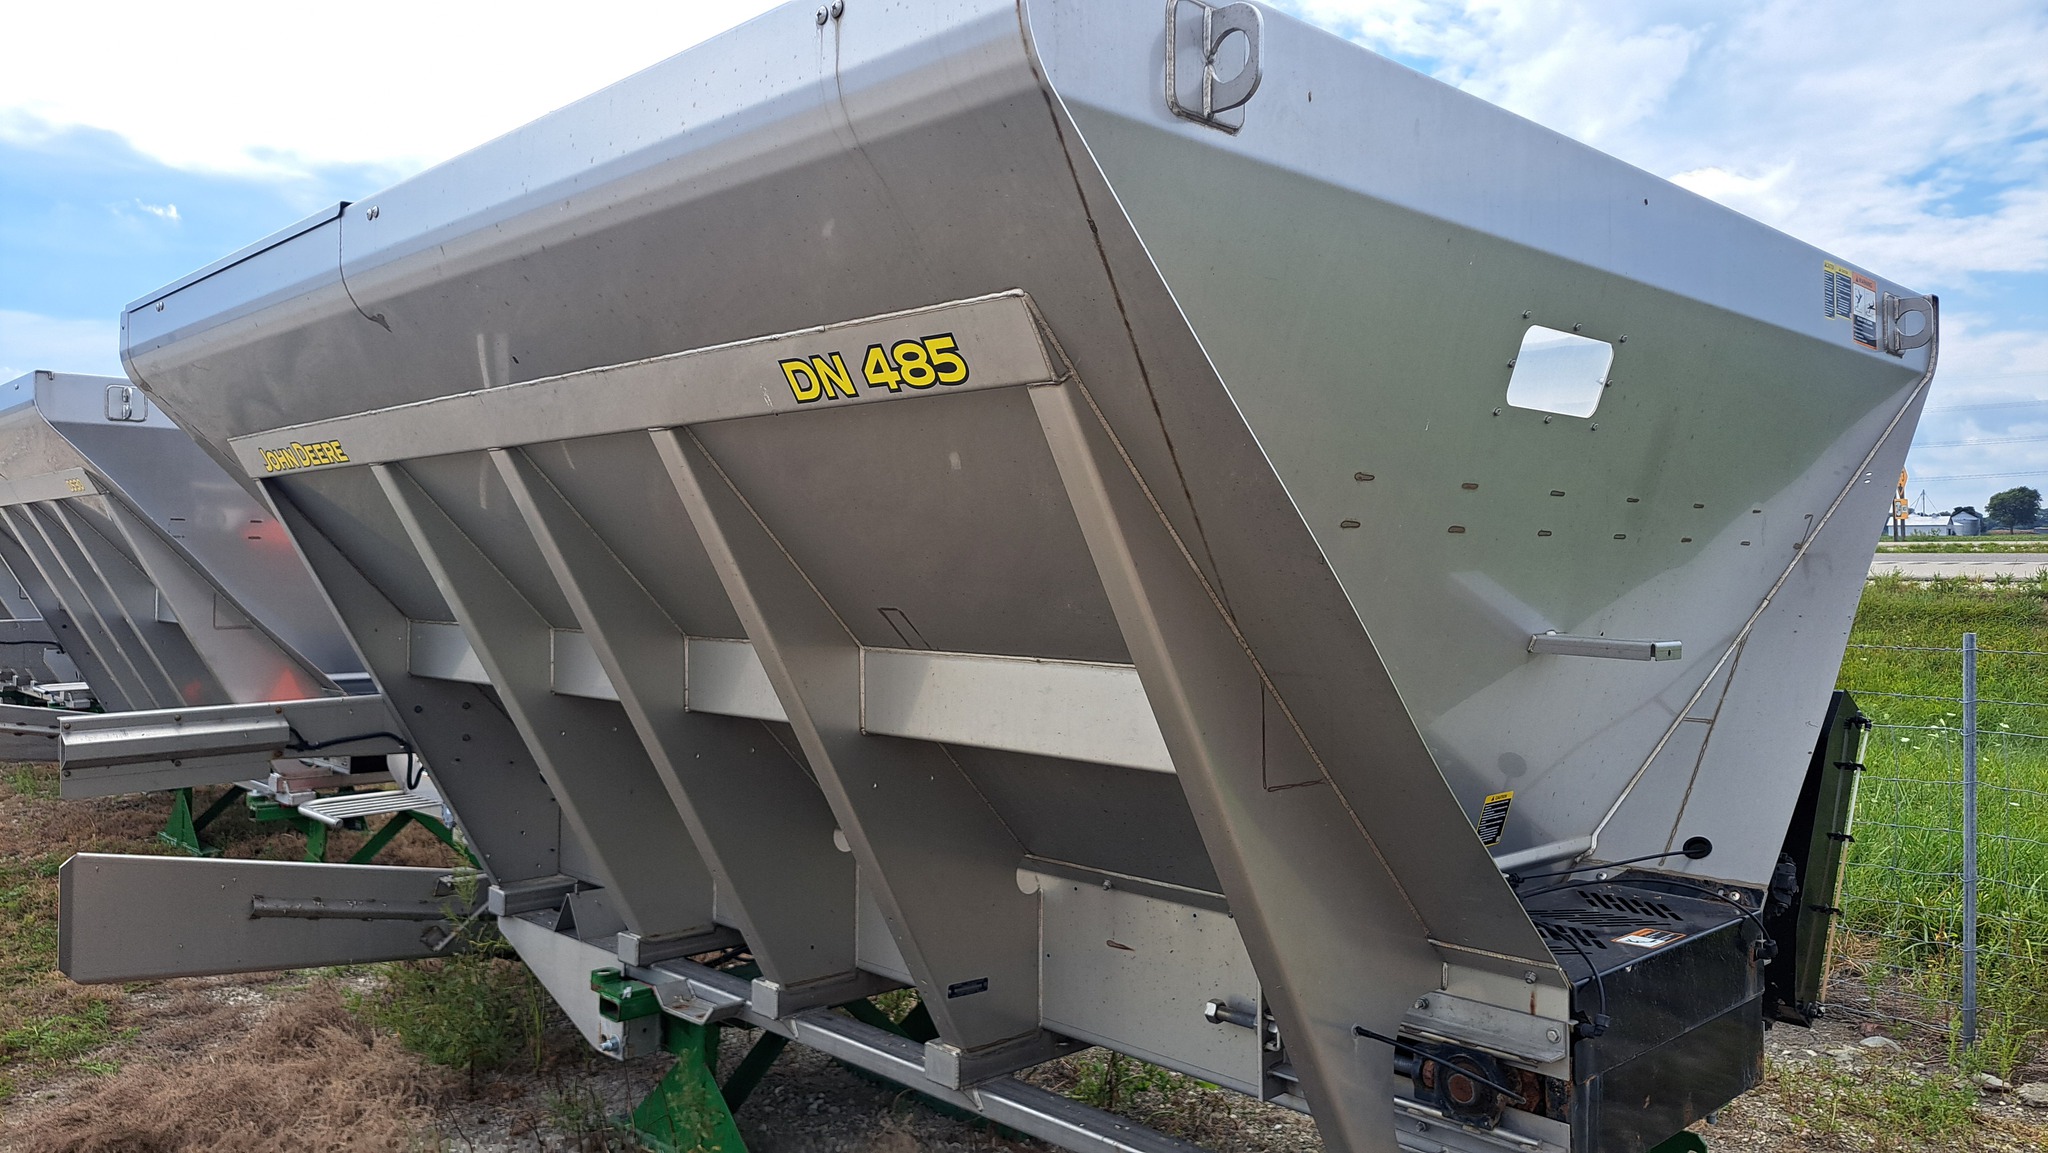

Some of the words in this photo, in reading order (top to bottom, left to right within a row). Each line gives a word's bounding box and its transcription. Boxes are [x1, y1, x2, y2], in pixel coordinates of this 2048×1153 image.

[778, 352, 859, 404] DN
[861, 332, 969, 393] 485
[259, 447, 301, 472] JOHN
[290, 440, 350, 467] DEERE
